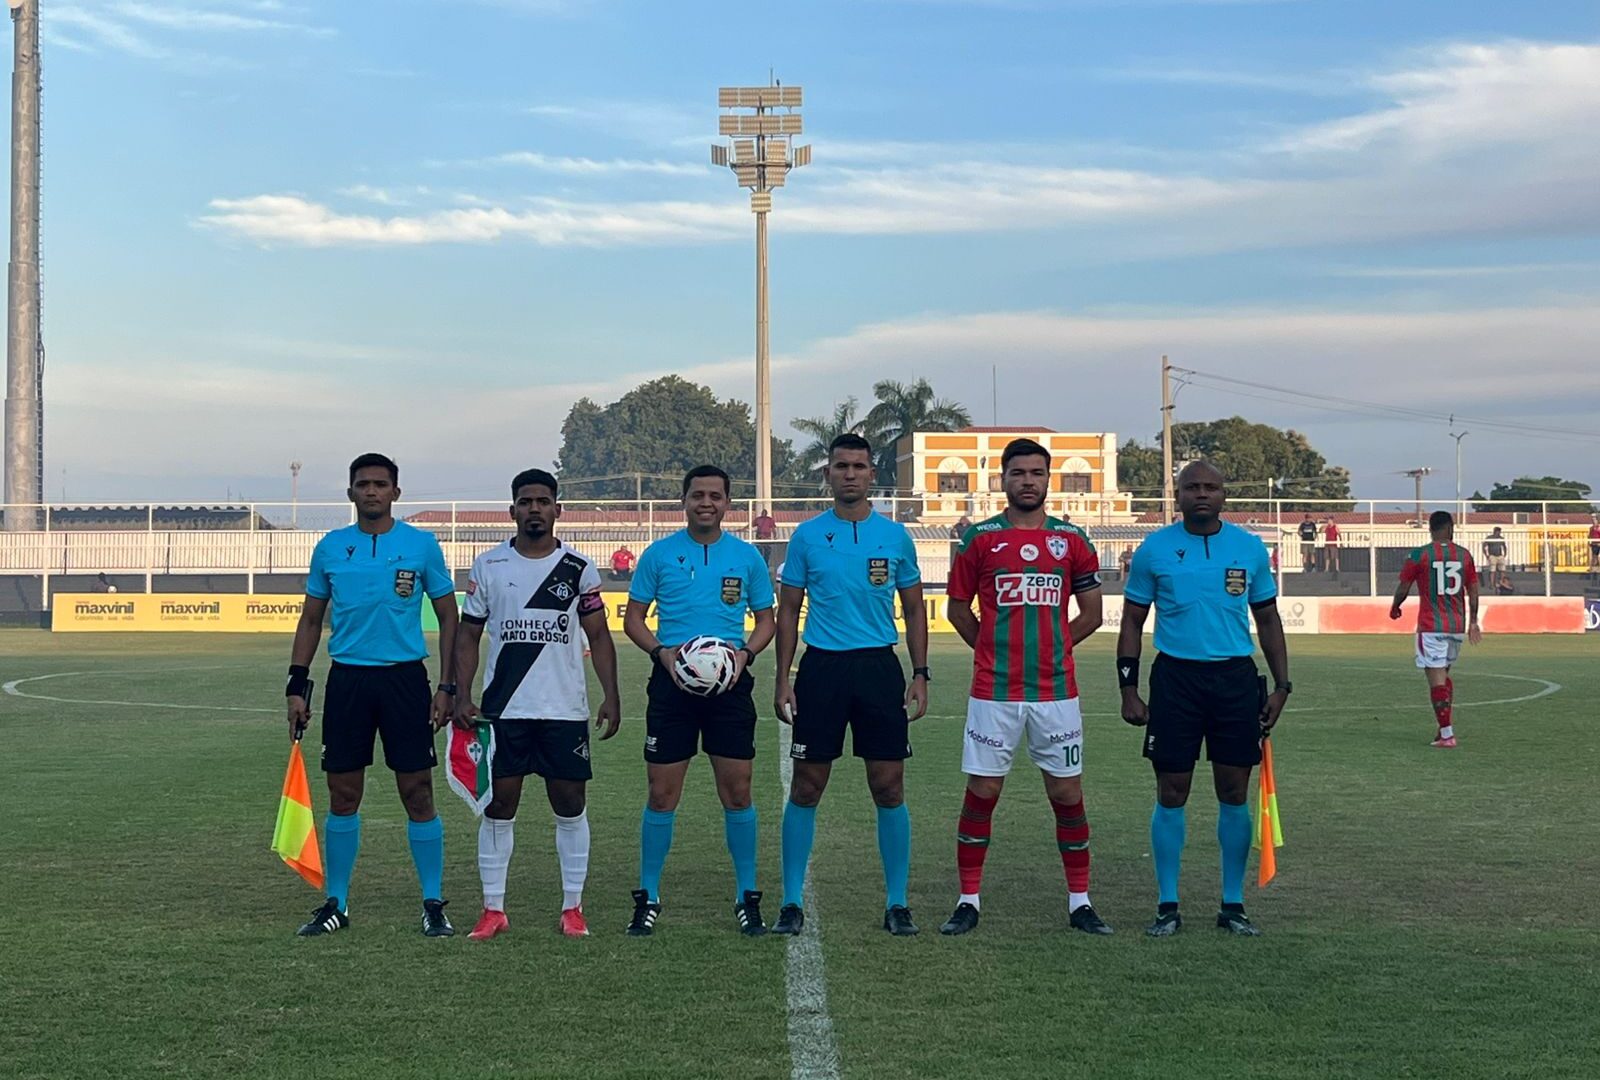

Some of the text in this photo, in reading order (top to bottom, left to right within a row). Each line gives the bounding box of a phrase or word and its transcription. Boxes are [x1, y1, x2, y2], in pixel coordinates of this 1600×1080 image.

[1026, 576, 1060, 588] zero
[1432, 561, 1462, 595] 13
[1027, 587, 1059, 603] um
[75, 601, 134, 614] maxvinil
[161, 601, 220, 614] maxvinil
[500, 630, 527, 641] MATO
[1063, 744, 1080, 767] 10
